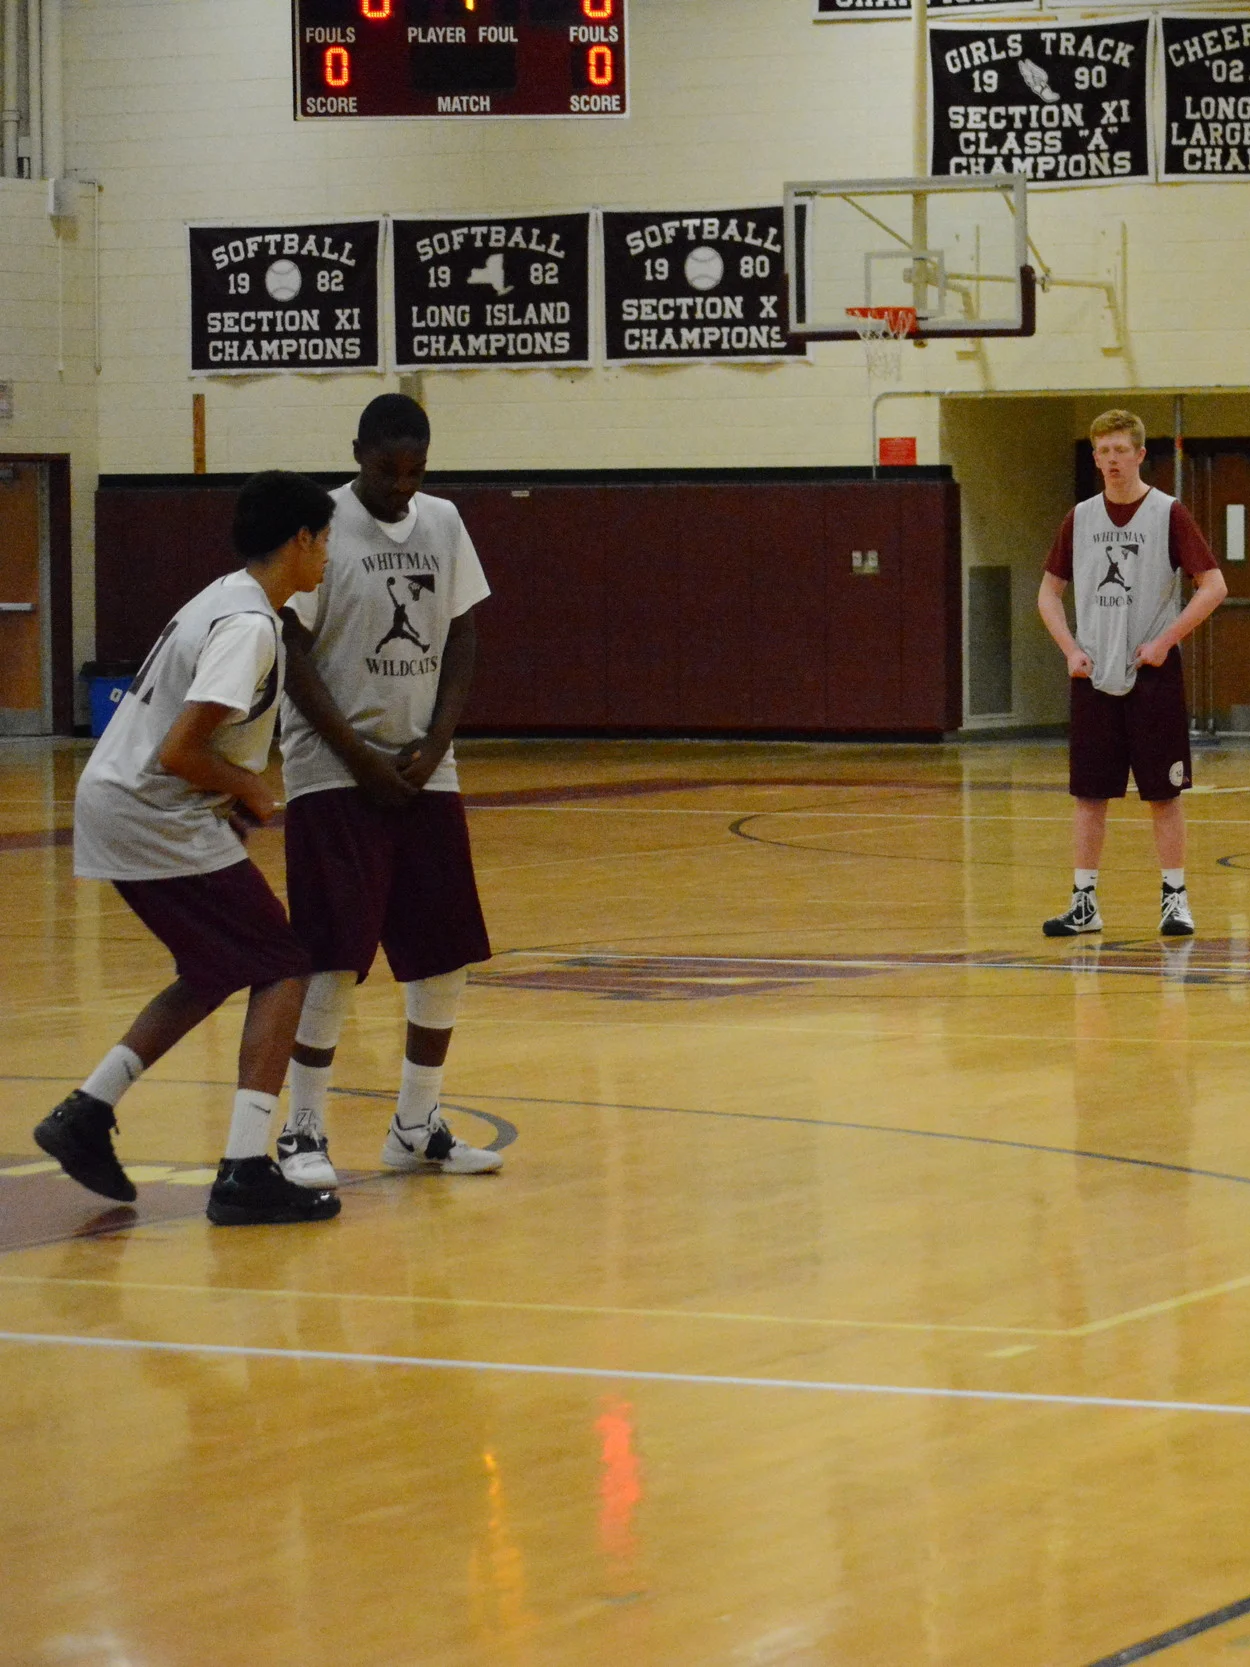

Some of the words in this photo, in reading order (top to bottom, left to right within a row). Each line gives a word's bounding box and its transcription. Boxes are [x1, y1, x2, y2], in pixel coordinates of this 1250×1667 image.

[305, 28, 356, 43] FOULS
[408, 28, 466, 43] PLAYER
[478, 27, 518, 43] FOUL
[569, 27, 619, 42] FOULS
[589, 46, 612, 85] 0
[945, 32, 1022, 75] GIRLS
[1041, 34, 1134, 67] TRACK
[325, 47, 348, 86] 0
[1205, 59, 1244, 83] '02
[973, 70, 998, 93] 19
[1074, 67, 1107, 90] 90
[306, 98, 358, 113] SCORE
[437, 97, 490, 112] MATCH
[570, 96, 620, 111] SCORE
[948, 105, 1083, 129] SECTION
[1101, 102, 1130, 122] XI
[959, 130, 1062, 155] CLASS
[1078, 127, 1119, 151] "A"
[949, 152, 1131, 176] CHAMPIONS
[416, 226, 565, 262] SOFTBALL
[625, 218, 782, 256] SOFTBALL
[211, 233, 356, 270] SOFTBALL
[428, 266, 451, 288] 19
[529, 262, 559, 285] 82
[644, 258, 669, 280] 19
[740, 255, 770, 278] 80
[228, 274, 250, 295] 19
[316, 270, 344, 293] 82
[208, 312, 319, 332] SECTION
[335, 309, 360, 331] XI
[411, 305, 470, 328] LONG
[486, 302, 570, 325] ISLAND
[622, 297, 743, 320] SECTION
[208, 336, 361, 362] CHAMPIONS
[413, 332, 570, 357] CHAMPIONS
[1093, 531, 1146, 545] WHITMAN
[362, 552, 440, 573] WHITMAN
[365, 655, 438, 677] WILDCATS
